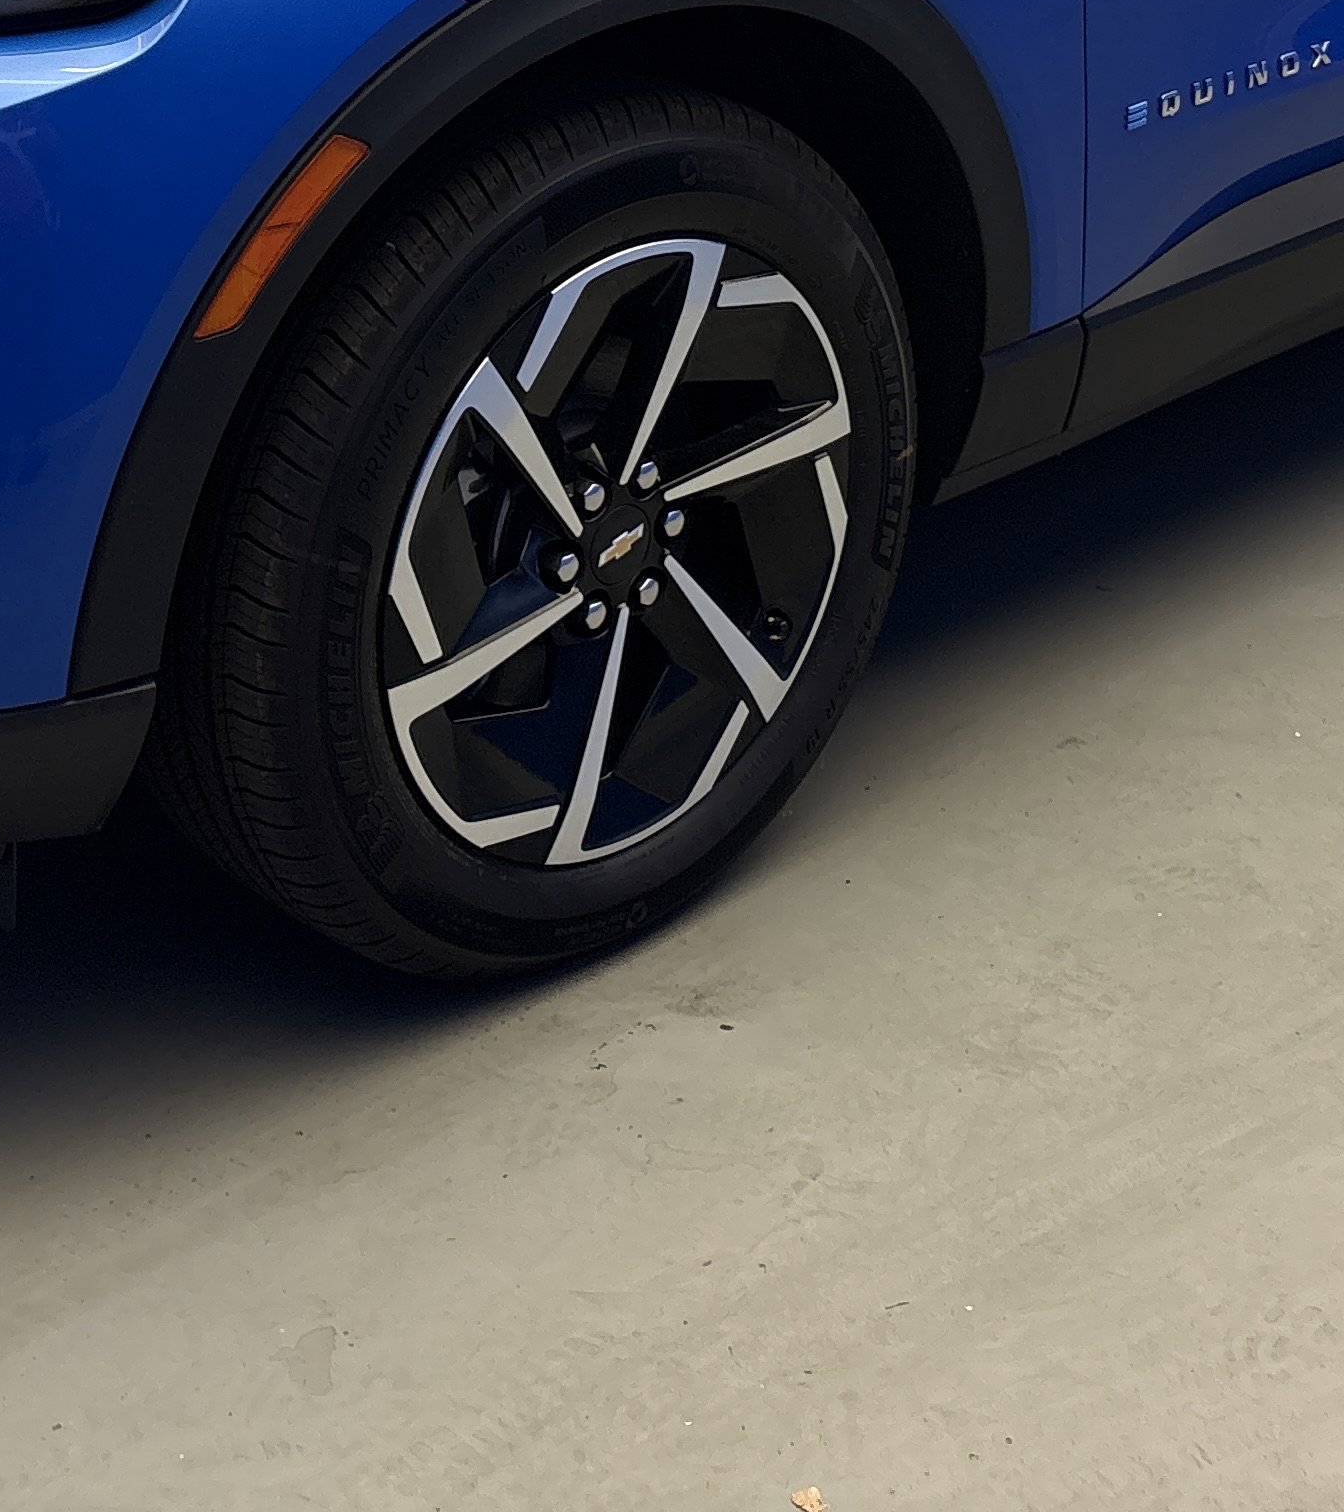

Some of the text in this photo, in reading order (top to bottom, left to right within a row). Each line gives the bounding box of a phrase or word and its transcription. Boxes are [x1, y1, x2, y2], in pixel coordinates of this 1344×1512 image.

[1123, 39, 1333, 131] EQUINOX
[356, 358, 431, 501] PRIMACY
[877, 342, 906, 560] MICHELIN
[326, 555, 371, 798] MICHELIN
